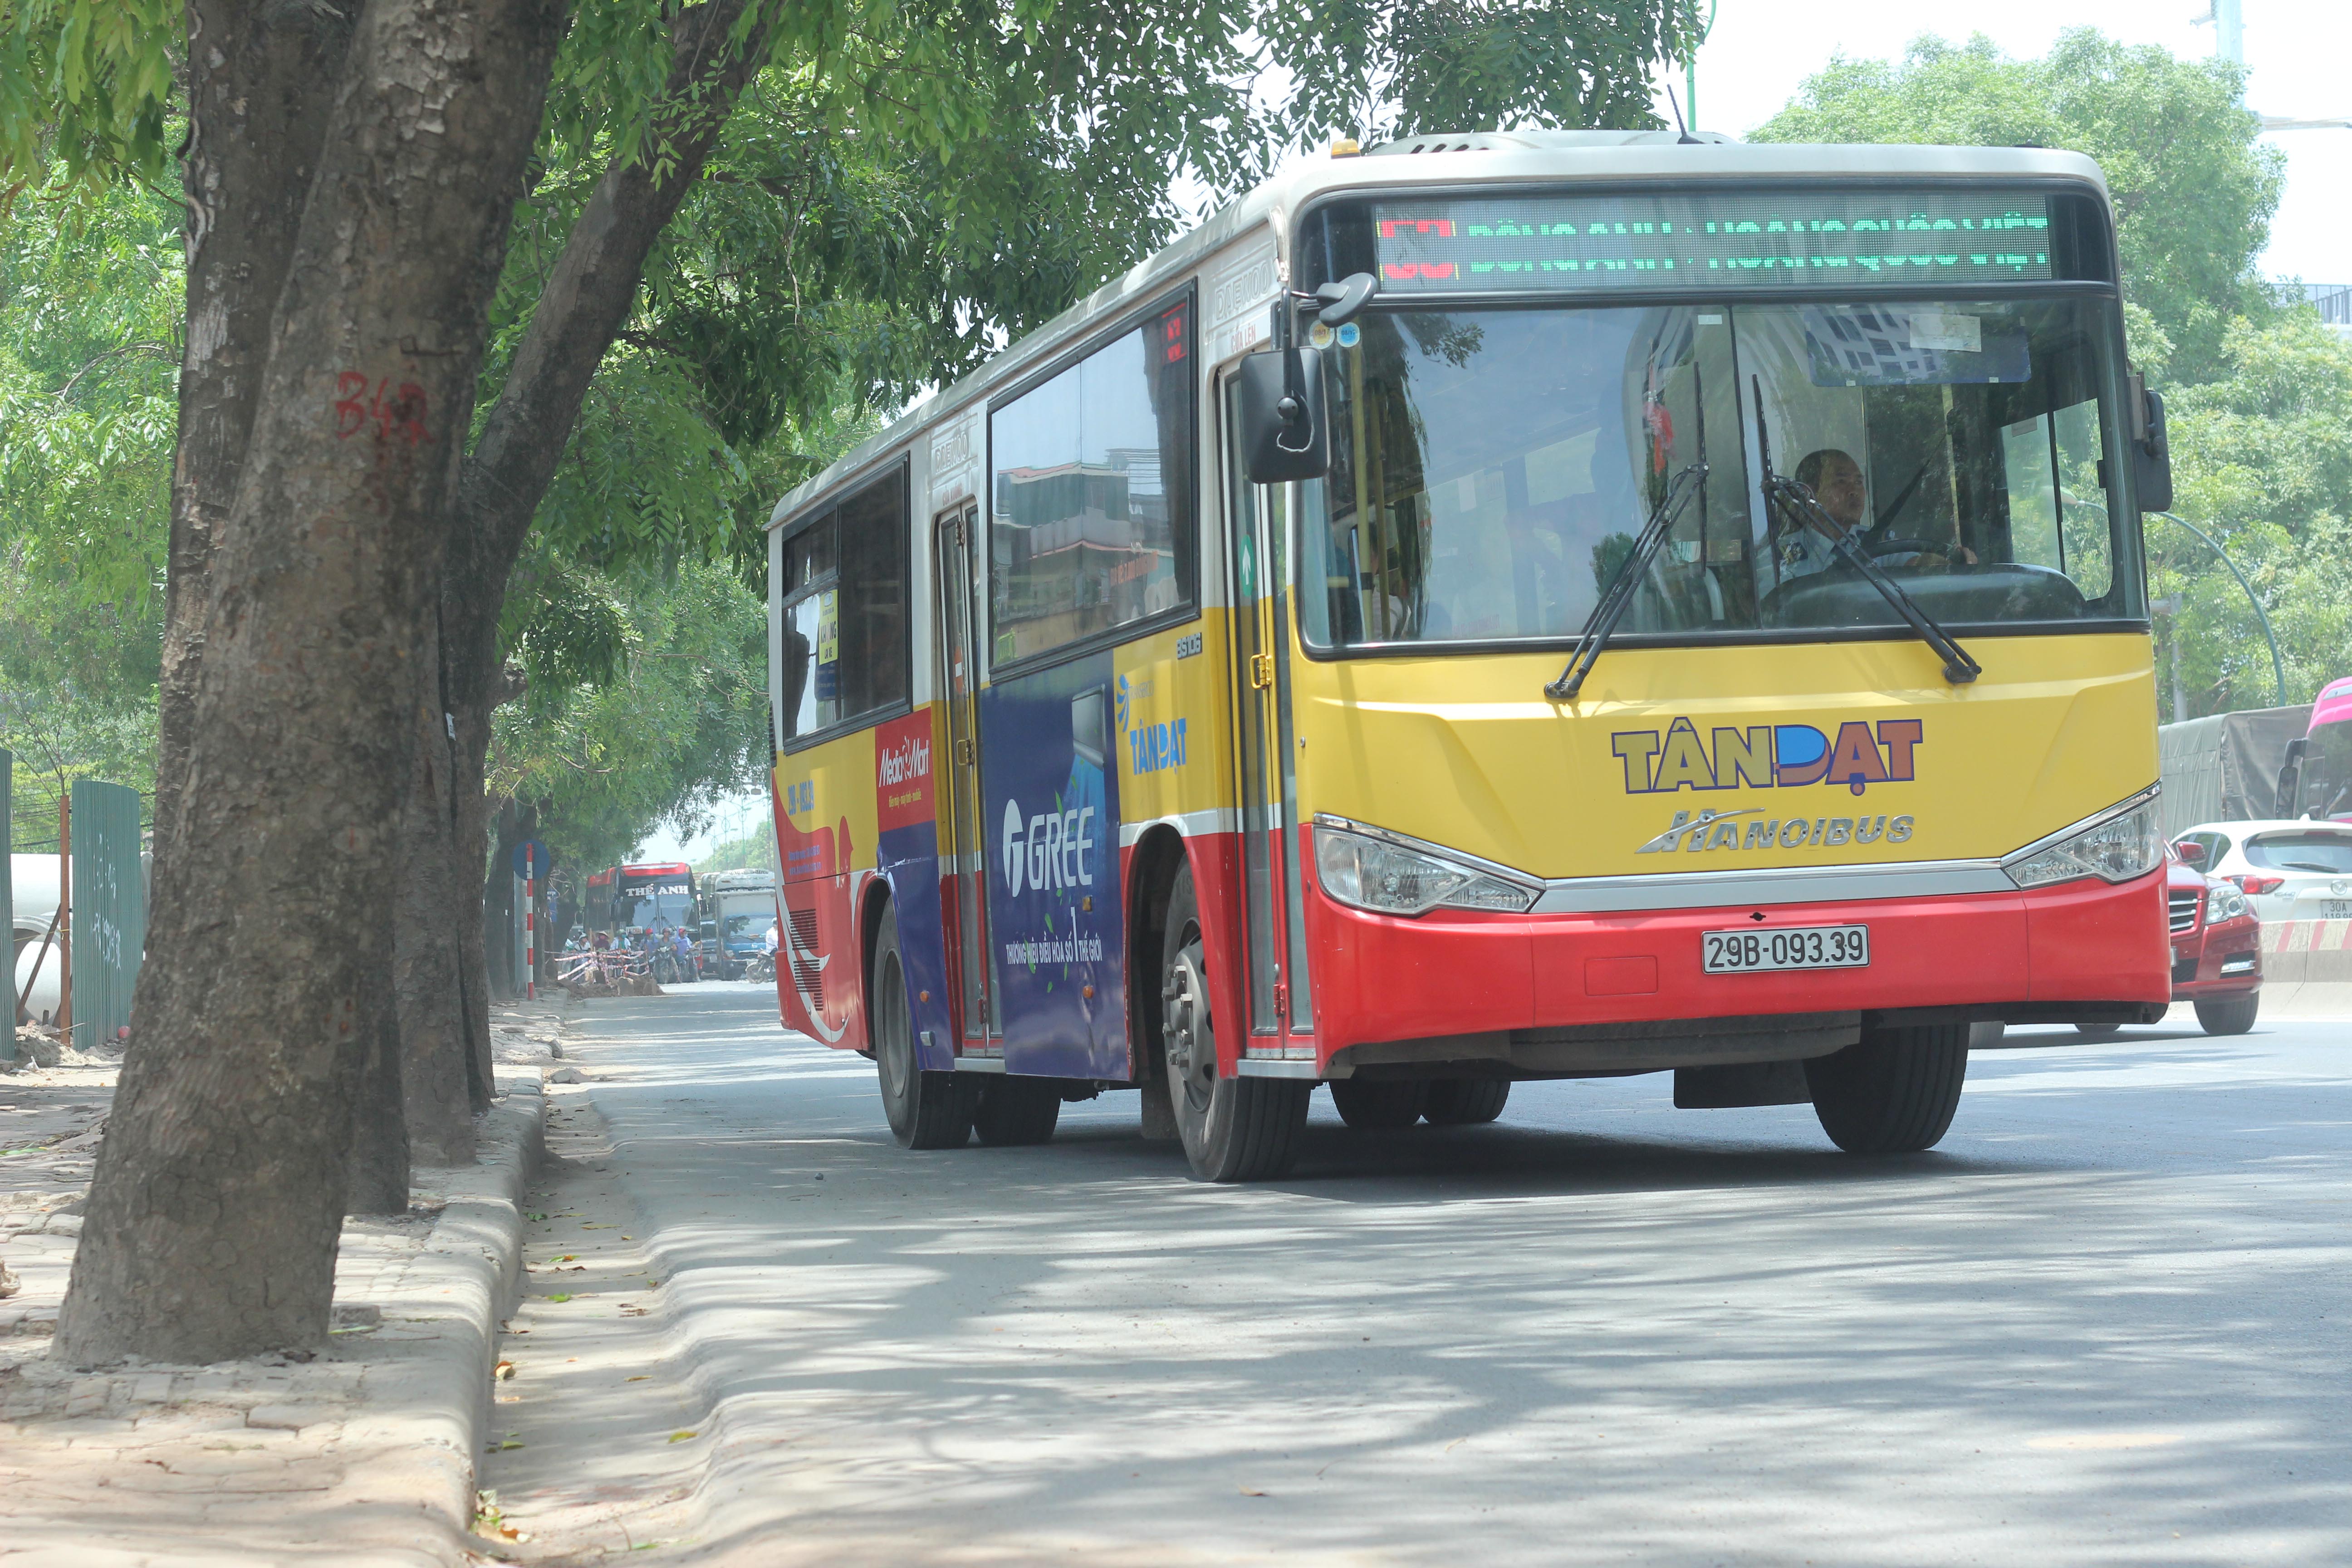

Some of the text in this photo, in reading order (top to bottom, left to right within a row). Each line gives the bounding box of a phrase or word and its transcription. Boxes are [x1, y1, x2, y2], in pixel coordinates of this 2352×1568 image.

[1215, 258, 1271, 321] DAEWOO
[1245, 323, 1256, 347] LÊN
[935, 432, 970, 475] DAEWOO
[1027, 805, 1094, 891] GREE
[1634, 808, 1916, 854] HANOIBUS
[625, 883, 689, 897] THẾ ANH
[2330, 902, 2347, 912] 30A
[1052, 935, 1065, 963] HÒA
[1065, 931, 1073, 962] SỐ
[1070, 906, 1079, 962] 1
[1078, 930, 1089, 962] THẾ
[1707, 930, 1864, 969] 29B-093.39
